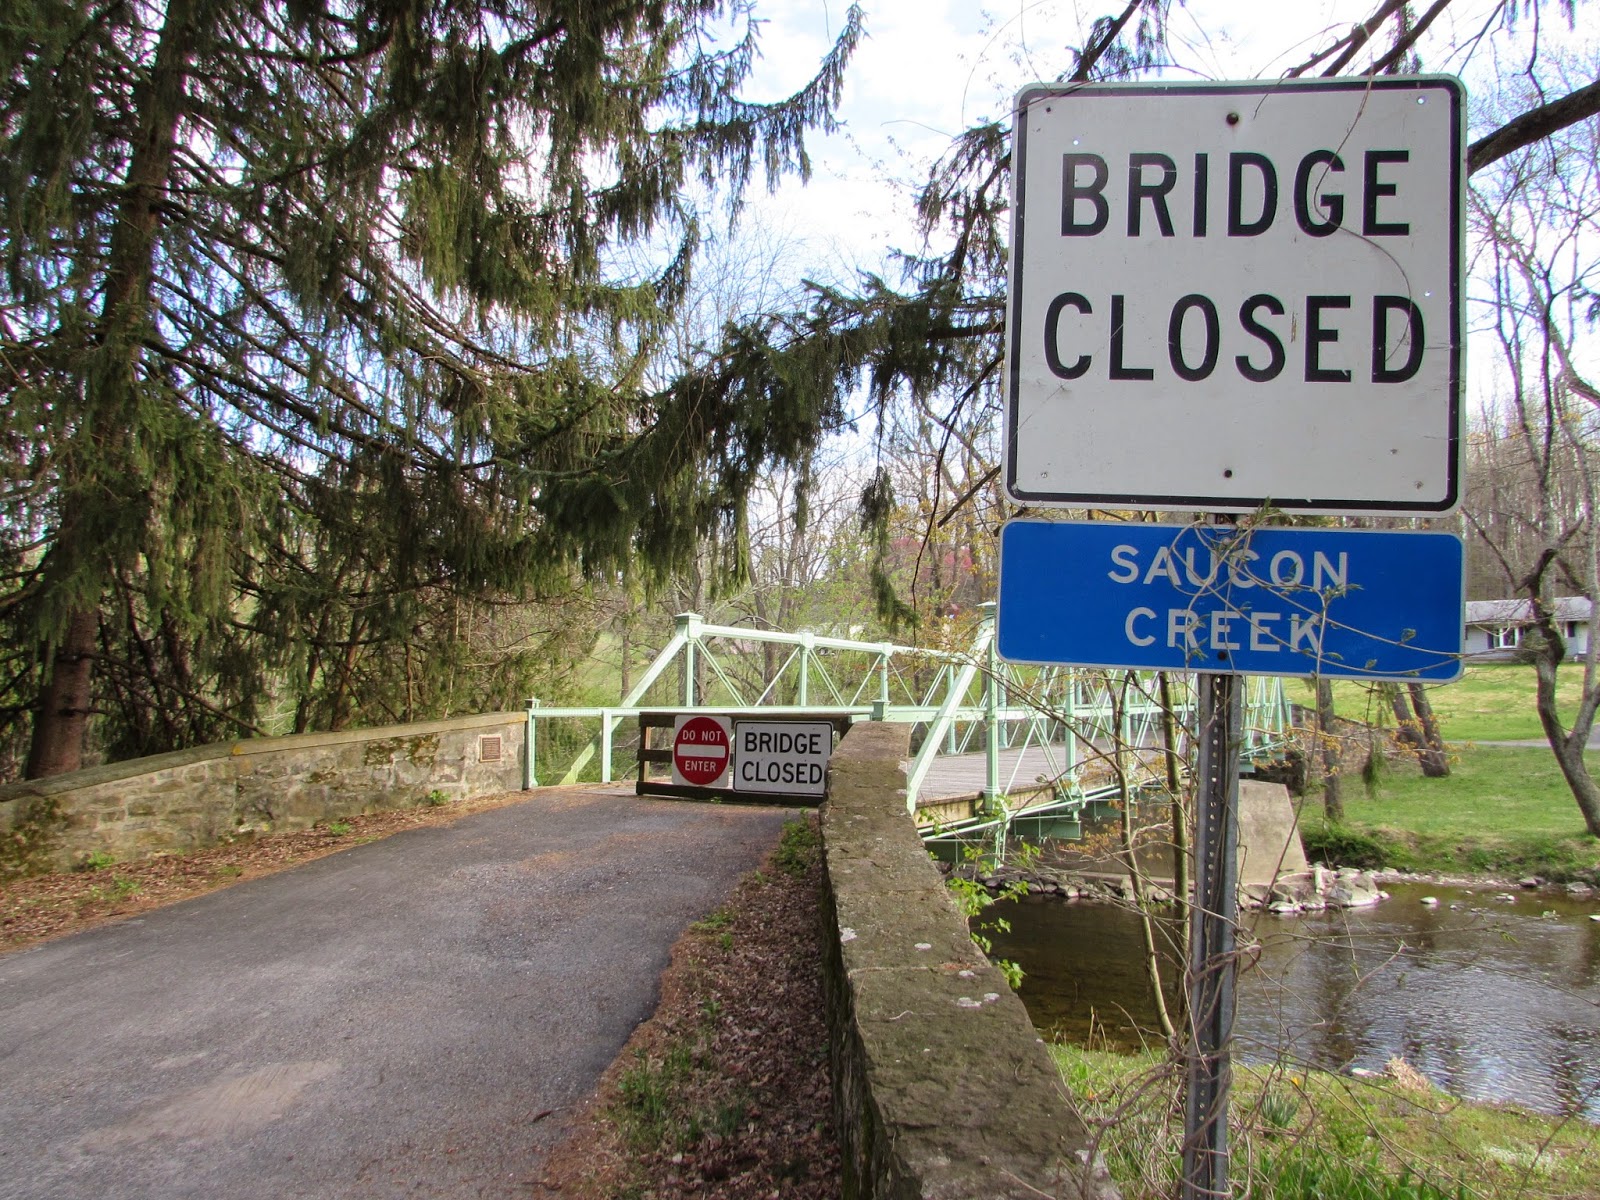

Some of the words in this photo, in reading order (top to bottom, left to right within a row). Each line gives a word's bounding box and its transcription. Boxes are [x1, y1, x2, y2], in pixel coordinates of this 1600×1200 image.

[1060, 150, 1411, 238] BRIDGE
[1043, 291, 1425, 384] CLOSED
[1107, 544, 1347, 592] SAUCON
[1124, 606, 1323, 654] CREEK
[682, 729, 696, 741] DO
[701, 730, 722, 742] NOT
[744, 732, 822, 755] BRIDGE
[684, 760, 717, 773] ENTER
[741, 761, 823, 785] CLOSED
